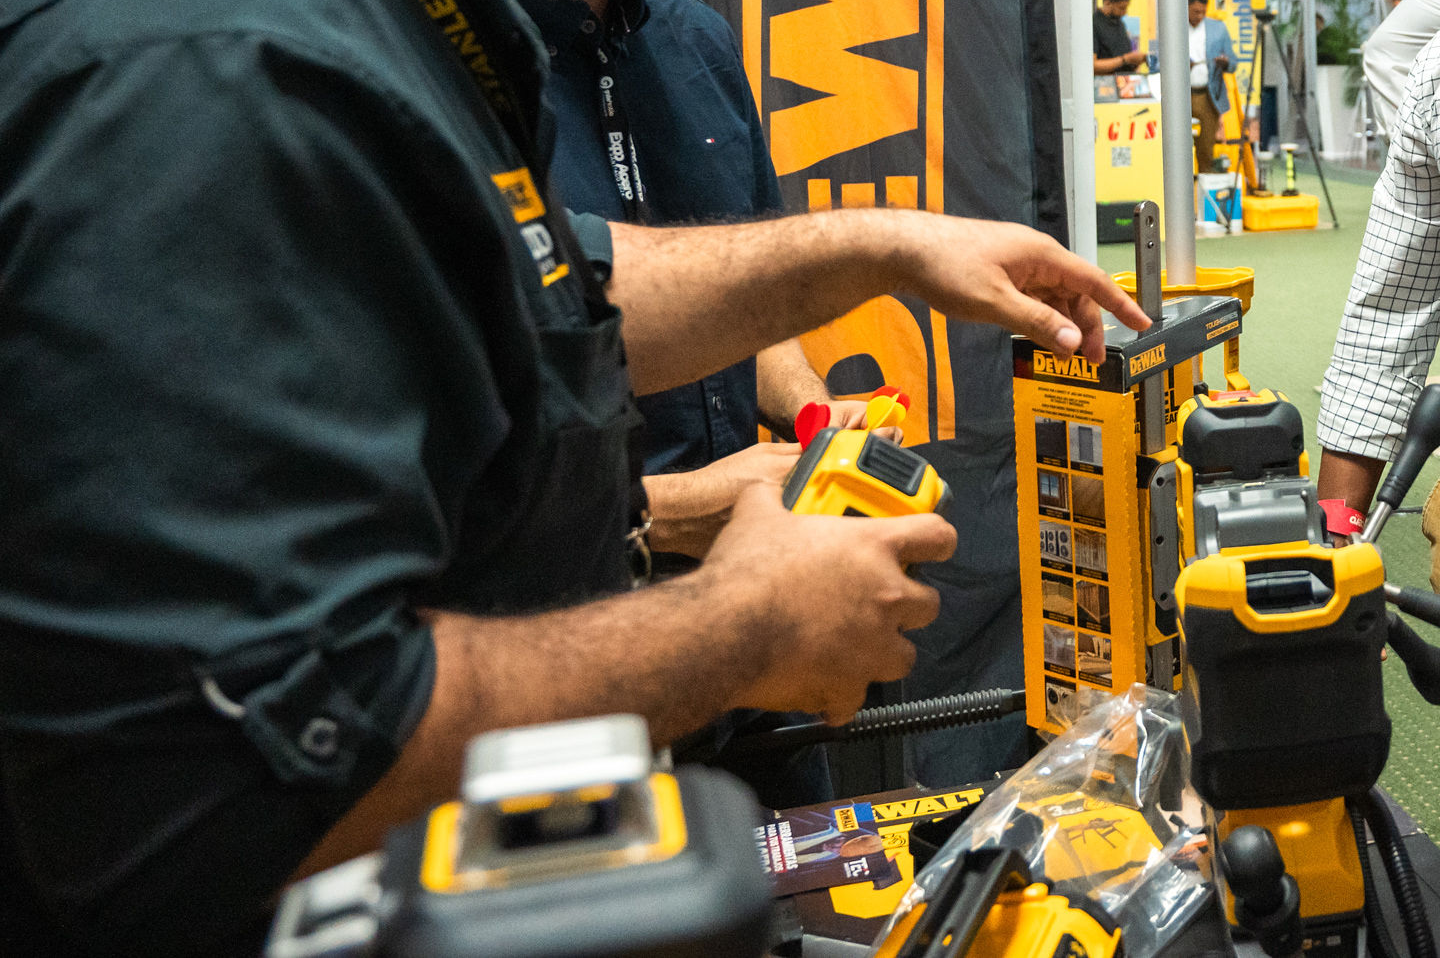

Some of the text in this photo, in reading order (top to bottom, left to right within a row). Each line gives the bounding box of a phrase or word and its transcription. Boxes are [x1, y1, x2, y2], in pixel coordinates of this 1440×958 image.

[616, 163, 634, 201] Acero
[1033, 351, 1100, 382] DEWALT
[1130, 344, 1167, 377] DEWALT
[873, 788, 985, 822] WALT
[779, 821, 799, 871] HERRAMIENTAS
